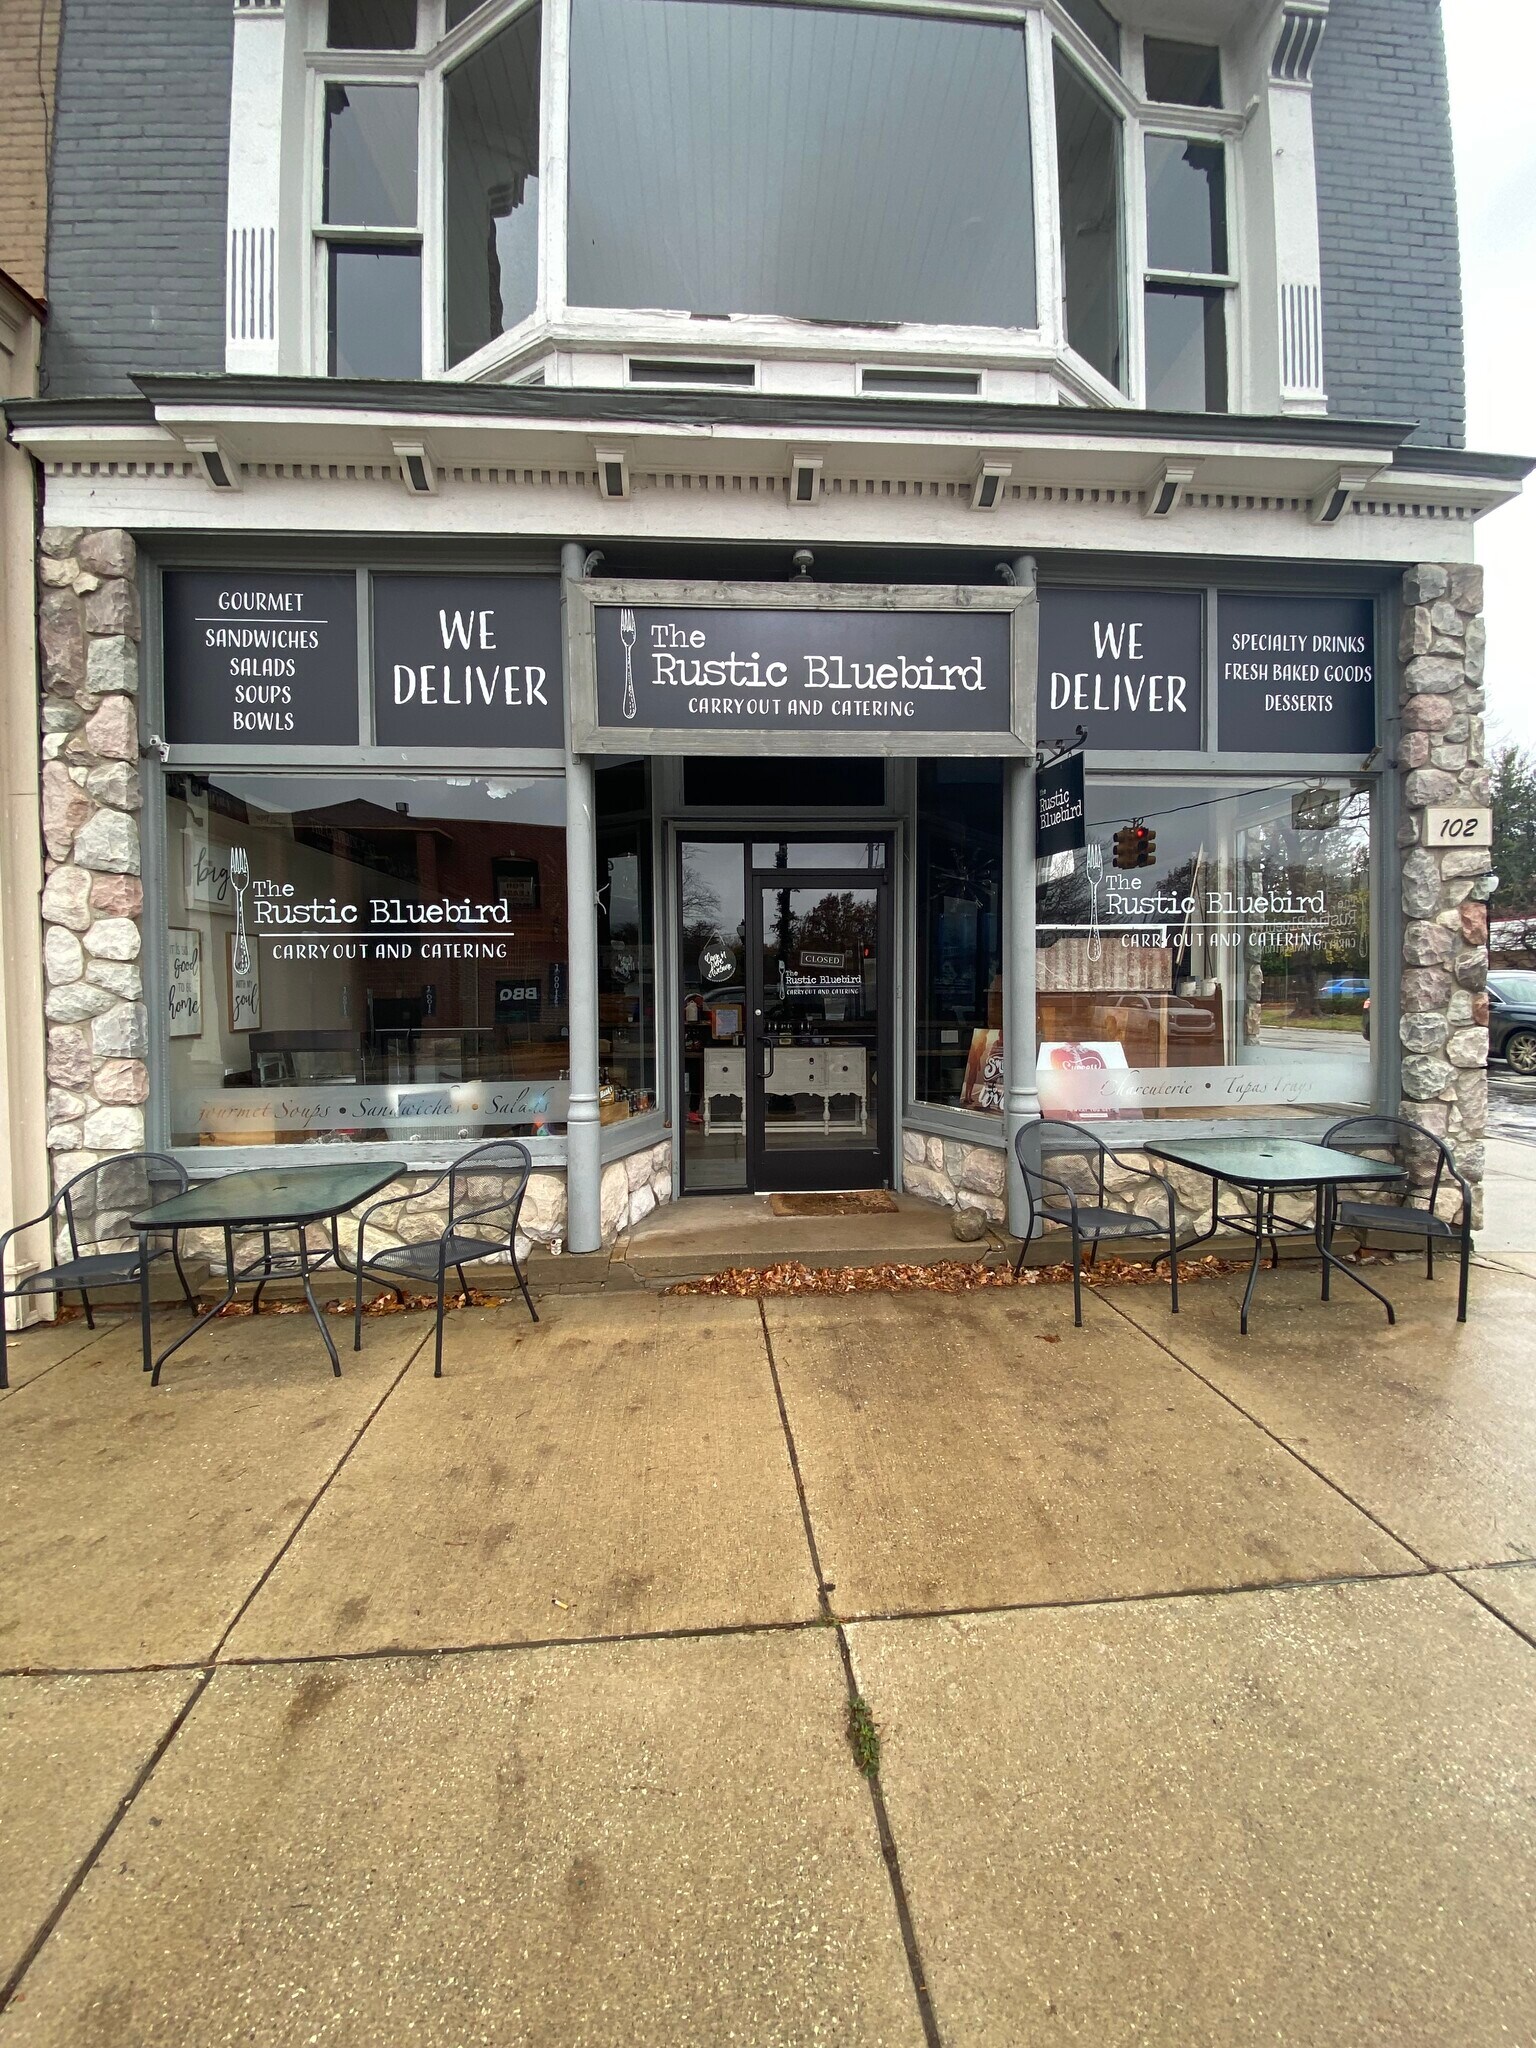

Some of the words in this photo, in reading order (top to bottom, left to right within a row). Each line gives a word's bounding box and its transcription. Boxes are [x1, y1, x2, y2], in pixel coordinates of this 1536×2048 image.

[218, 591, 304, 612] GOURMET
[205, 628, 320, 649] SANDWICHES
[438, 609, 498, 651] WE
[650, 623, 706, 649] The
[1092, 620, 1144, 660] WE
[1231, 632, 1308, 653] SPECIALTY
[1312, 635, 1366, 654] DRINKS
[229, 657, 296, 678] SALADS
[651, 651, 789, 688] Rustic
[803, 655, 987, 691] Bluebird
[1224, 662, 1268, 681] FRESH
[1273, 664, 1320, 683] BAKED
[1323, 664, 1373, 684] GOODS
[234, 685, 292, 705] SOUPS
[393, 664, 549, 706] DELIVER
[1049, 672, 1187, 713] DELIVER
[688, 696, 780, 715] CARRYOUT
[787, 699, 824, 717] AND
[831, 700, 916, 718] CATERING
[1264, 693, 1334, 713] DESSERTS
[232, 711, 295, 732] BOWLS
[1040, 788, 1070, 813] Rustic
[1040, 800, 1083, 830] Bluebird
[1439, 818, 1479, 838] 102
[252, 880, 295, 899] The
[1105, 874, 1143, 891] The
[253, 896, 358, 924] Rustic
[370, 898, 512, 923] Bluebird
[1105, 890, 1196, 915] Rustic
[1206, 891, 1327, 915] Bluebird
[272, 943, 369, 959] CARRYOUT
[375, 943, 413, 959] AND
[420, 943, 508, 960] CATERING
[1121, 933, 1203, 949] CARRYOUT
[1209, 932, 1242, 947] AND
[1248, 932, 1322, 948] CATERING
[805, 955, 840, 965] CLOSED
[785, 969, 799, 977] The
[785, 975, 817, 985] Rustic
[819, 974, 862, 984] Bluebird
[1100, 1069, 1193, 1097] Charcuterie
[1224, 1074, 1268, 1103] Tapas
[275, 1099, 331, 1129] Soups
[485, 1086, 556, 1115] Salads
